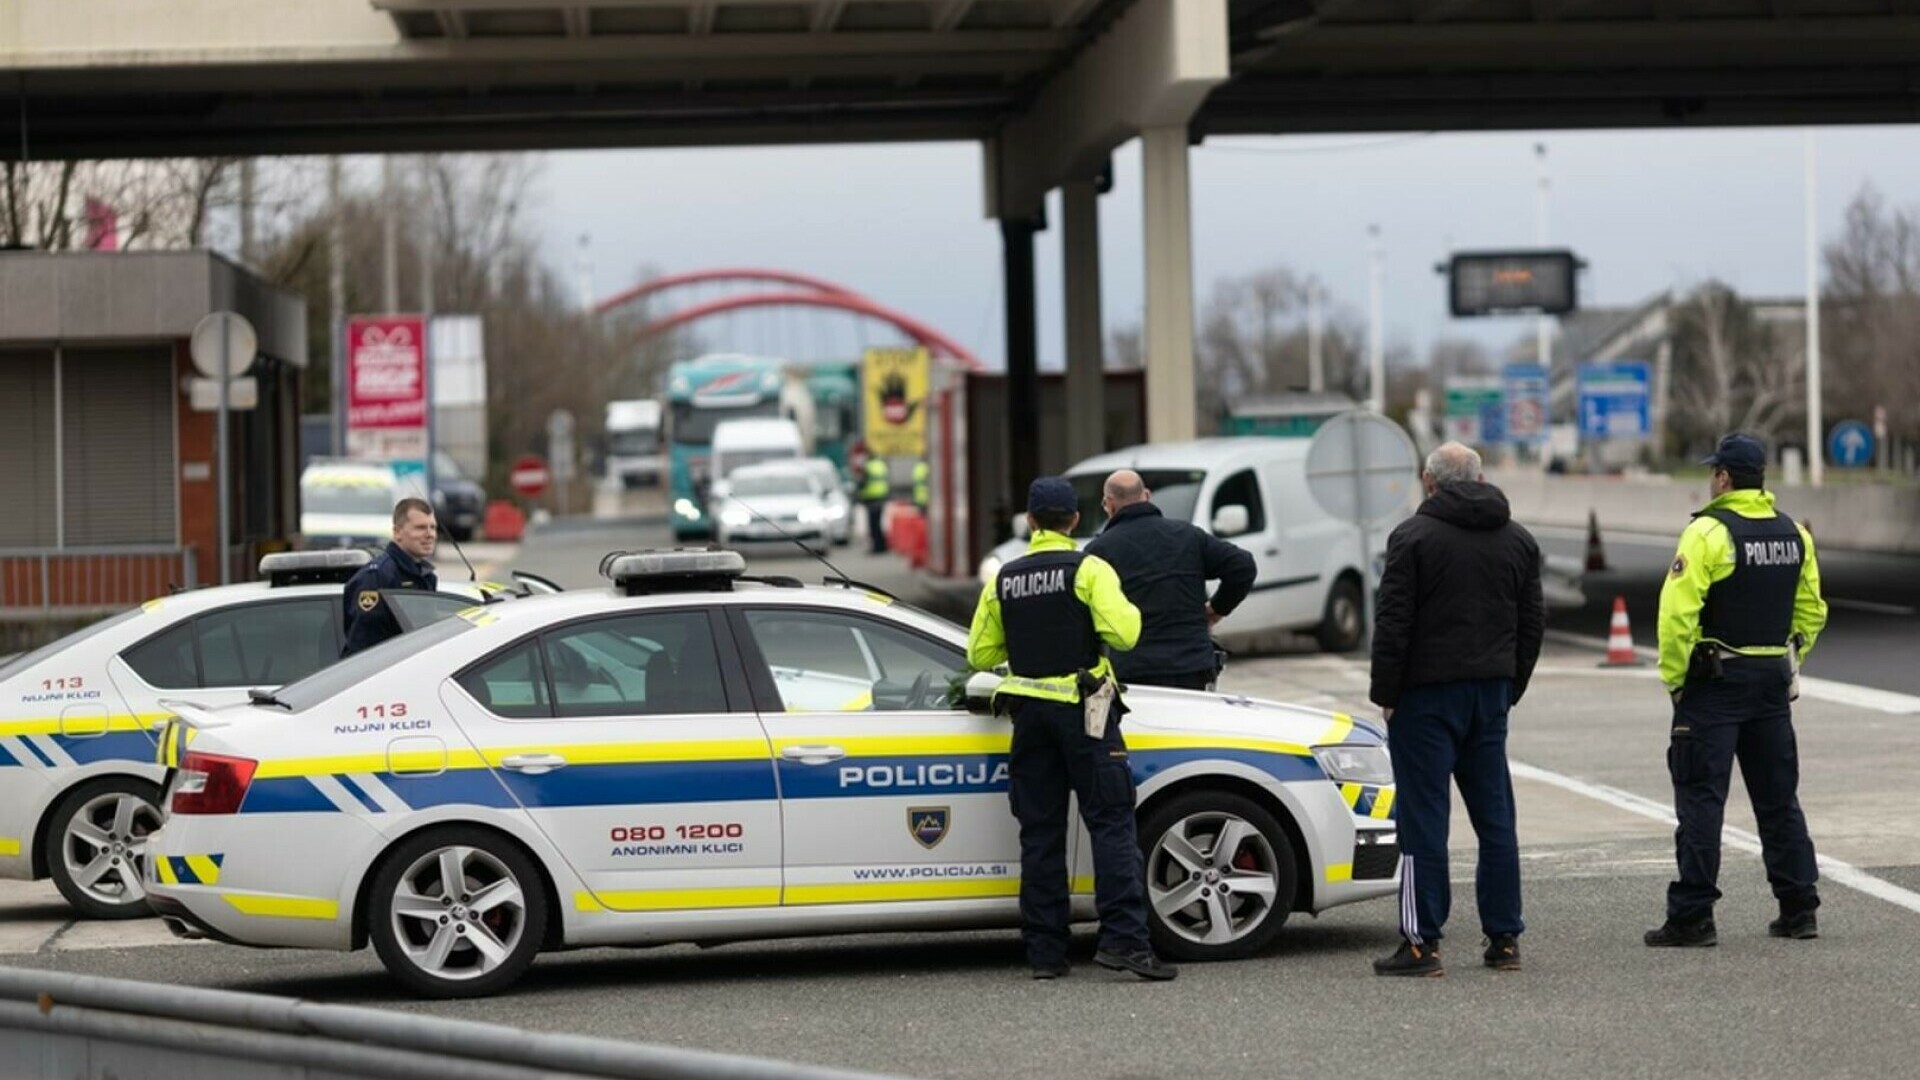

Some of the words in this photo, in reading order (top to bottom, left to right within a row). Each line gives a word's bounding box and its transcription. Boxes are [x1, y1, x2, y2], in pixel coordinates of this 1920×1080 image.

[1745, 541, 1799, 565] POLICIJA
[1002, 569, 1066, 599] POLICIJA
[42, 677, 83, 690] 113
[22, 693, 64, 702] NUJNI
[67, 690, 101, 699] KLICI
[356, 703, 407, 718] 113
[334, 723, 385, 733] NUJNI
[390, 720, 431, 730] KLICI
[839, 763, 1009, 788] POLICIJA
[611, 826, 665, 841] 080
[676, 823, 743, 839] 1200
[611, 845, 698, 856] ANONIMNI
[702, 843, 743, 853] KLICI
[853, 865, 1008, 879] WWW.POLICIJA.SI
